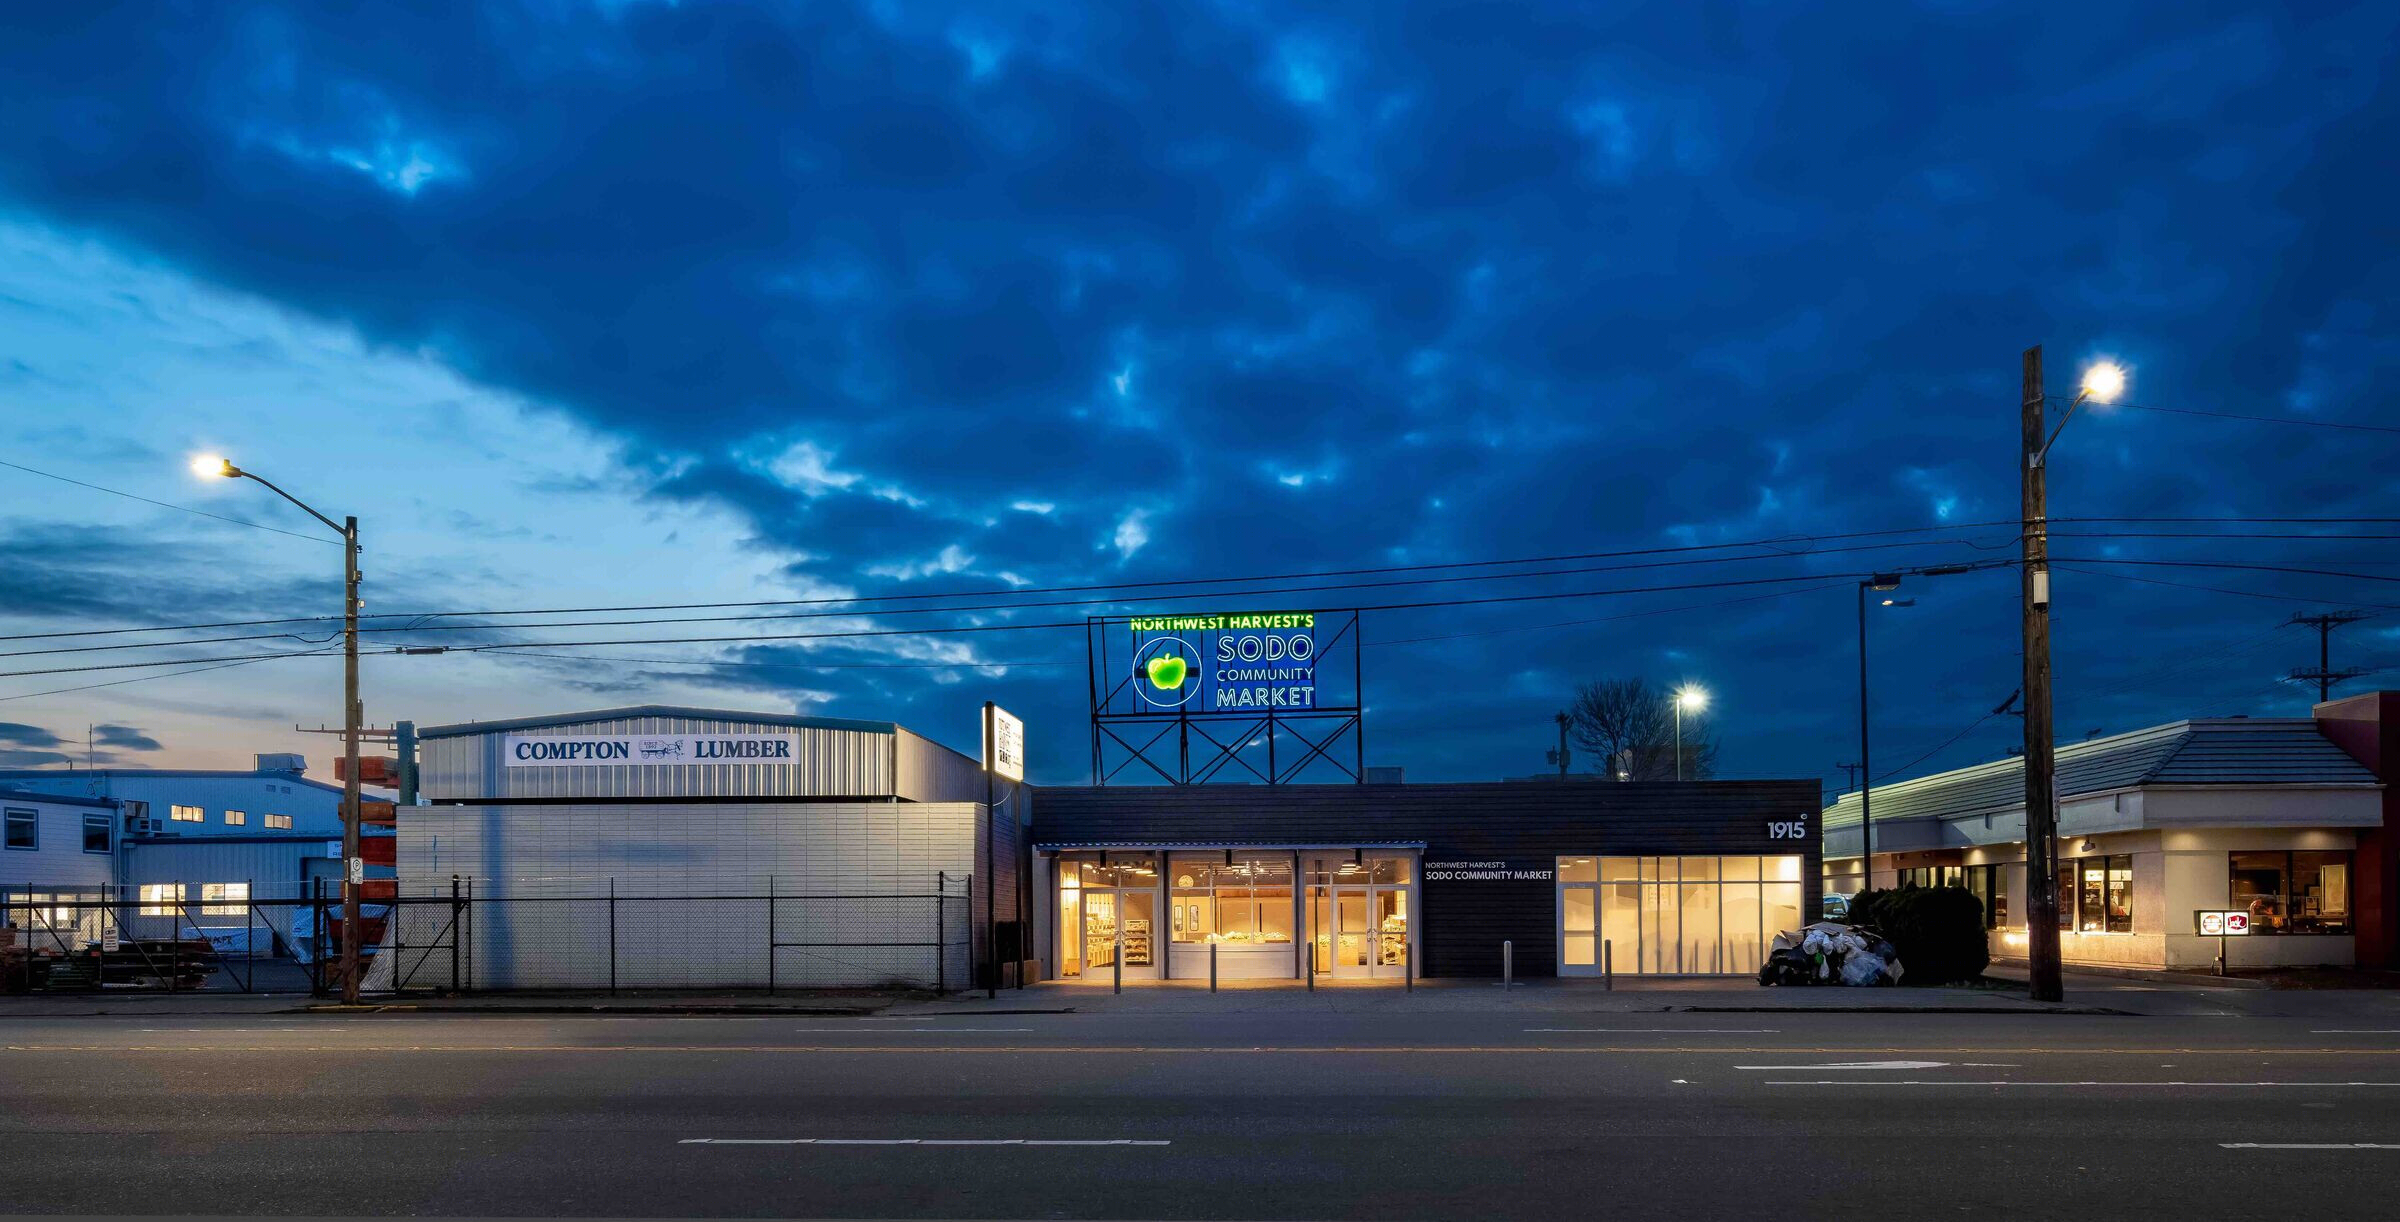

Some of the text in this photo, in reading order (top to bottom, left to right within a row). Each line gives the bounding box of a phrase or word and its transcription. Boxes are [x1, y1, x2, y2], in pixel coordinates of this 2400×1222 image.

[1130, 614, 1314, 631] NORTHWEST HARVEST'S
[1216, 634, 1314, 662] SODO
[1216, 667, 1314, 682] COMMUNITY
[1216, 686, 1315, 707] MARKET
[515, 740, 791, 760] COMPTON LUMBER
[1767, 821, 1806, 839] 1915
[1425, 861, 1506, 869] NORTHWEST HARVEST'S
[1425, 870, 1553, 880] SODO COMMUNITY MARKET
